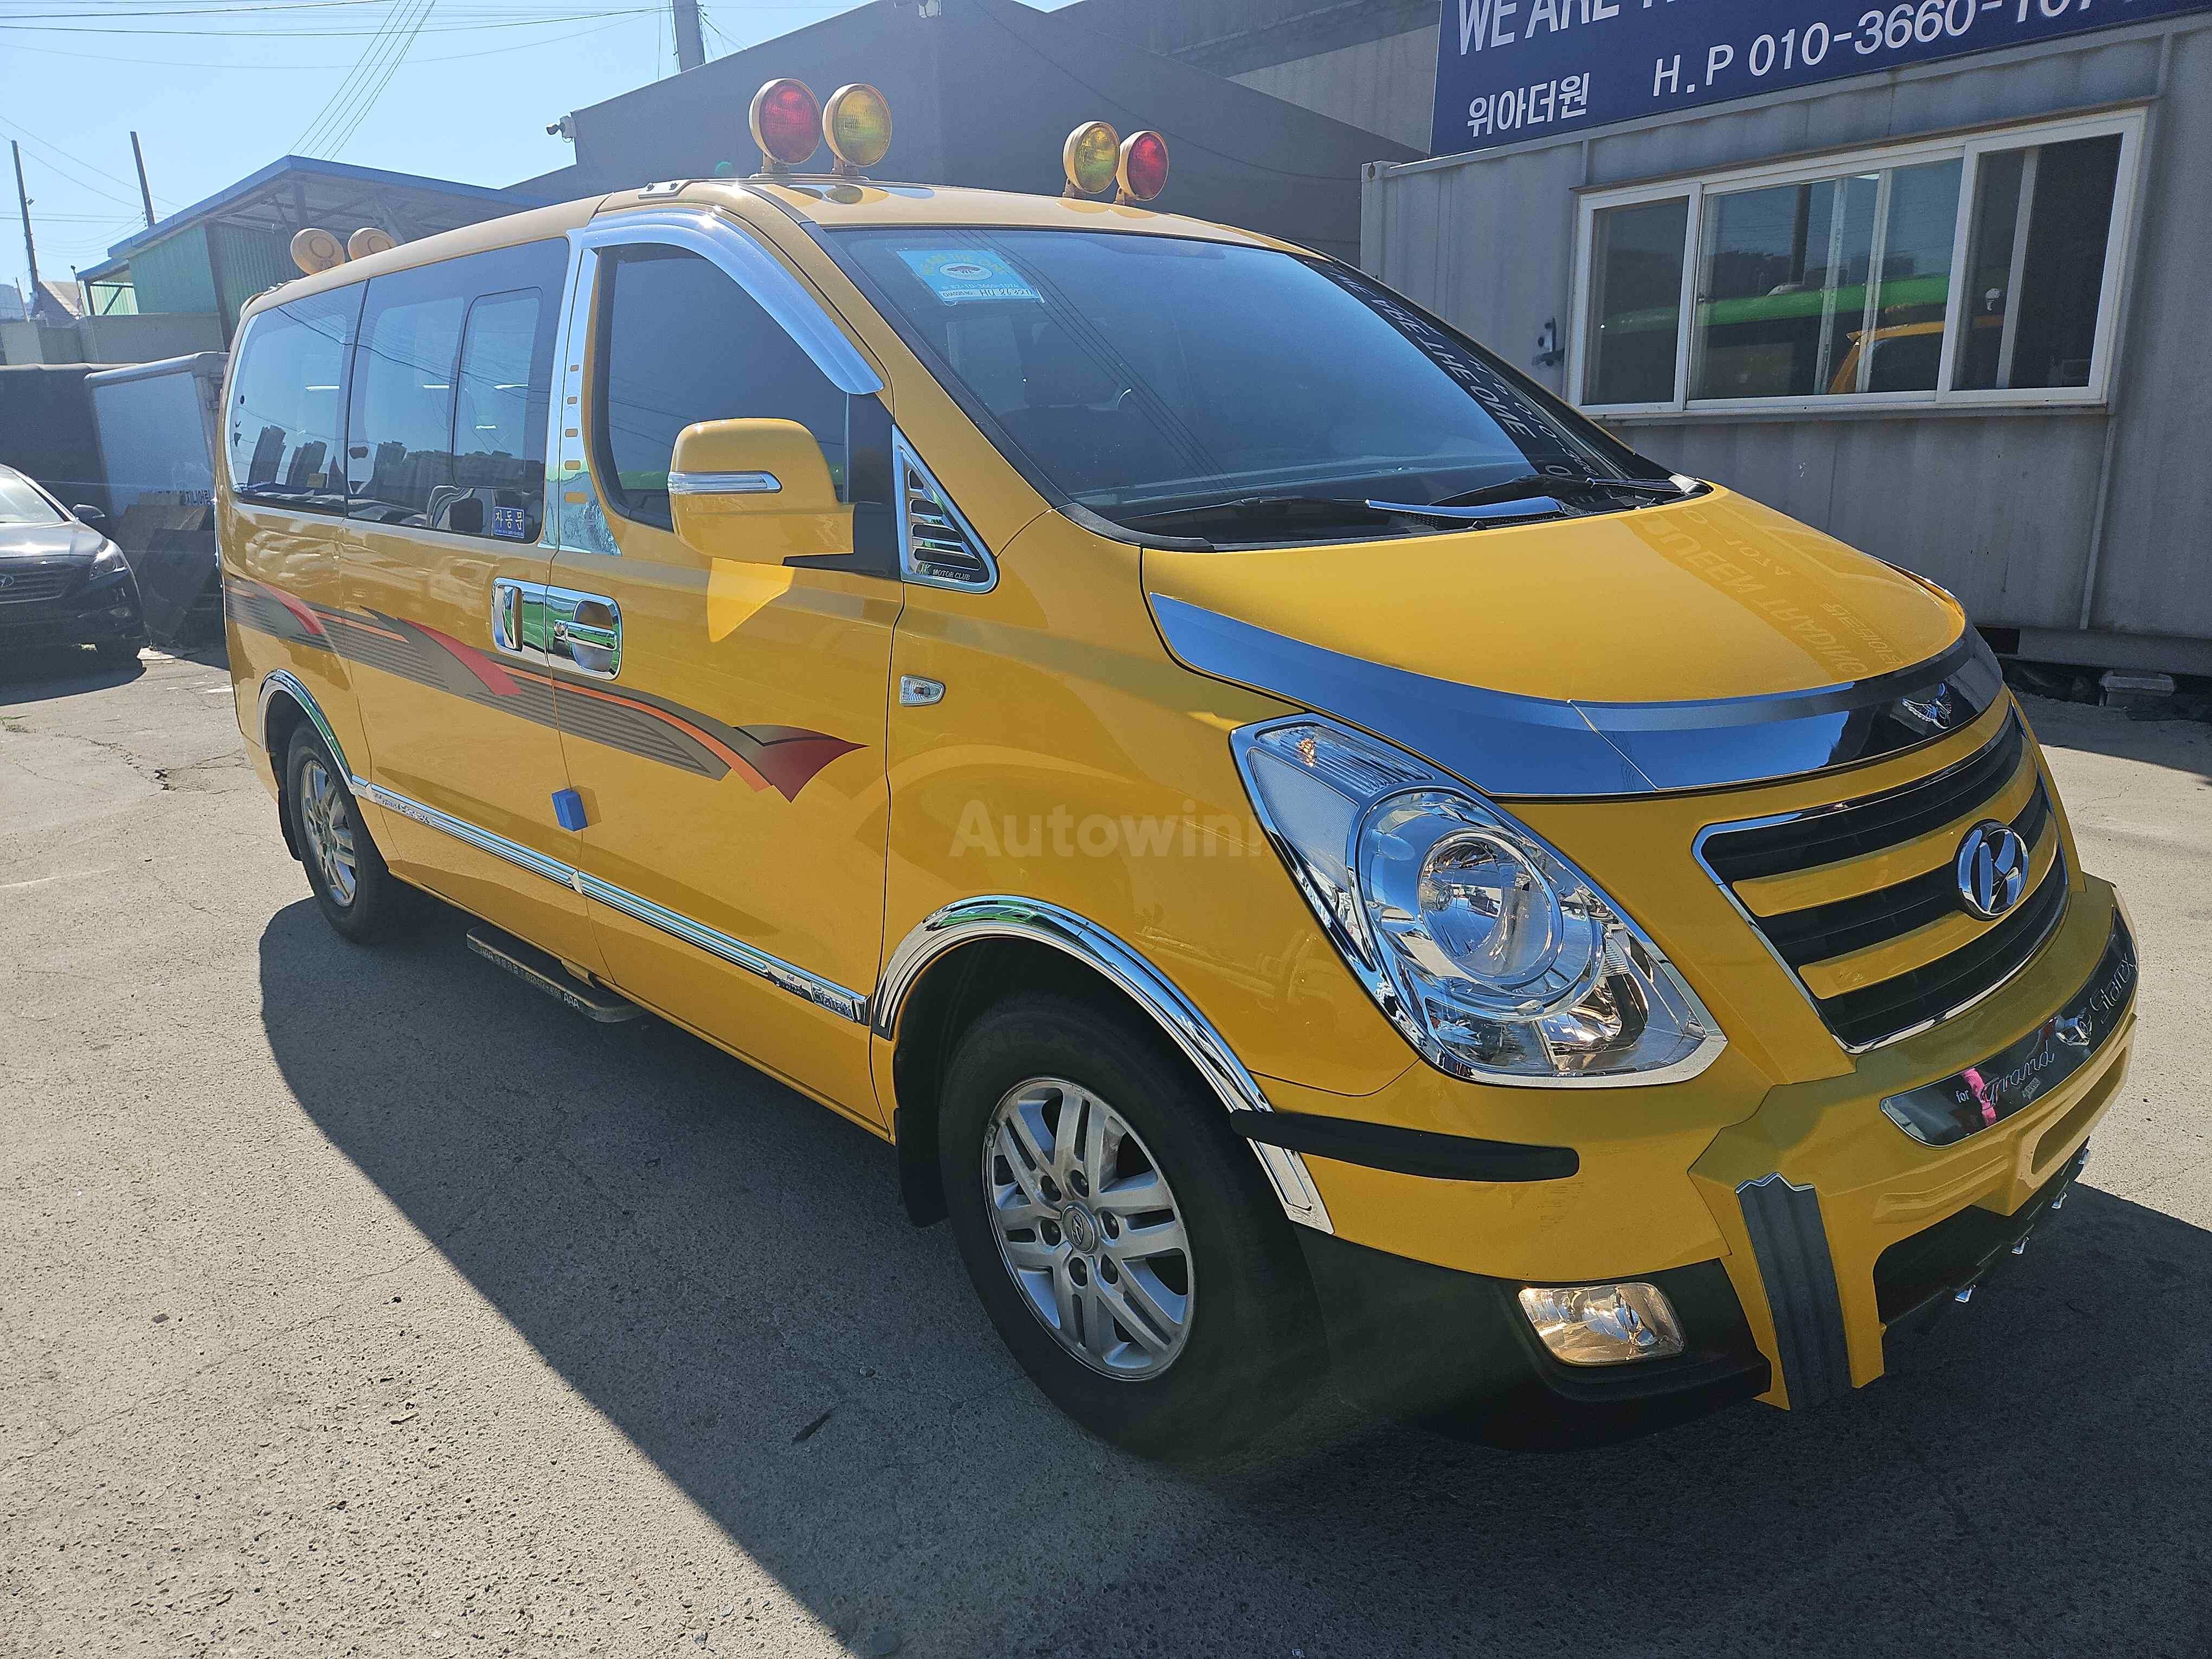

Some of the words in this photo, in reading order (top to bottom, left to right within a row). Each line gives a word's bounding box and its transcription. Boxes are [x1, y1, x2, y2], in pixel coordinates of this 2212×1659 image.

[1467, 72, 1590, 137] 위아더원
[495, 509, 523, 530] 자동문
[955, 572, 970, 581] CLUB
[1956, 1089, 1969, 1103] for
